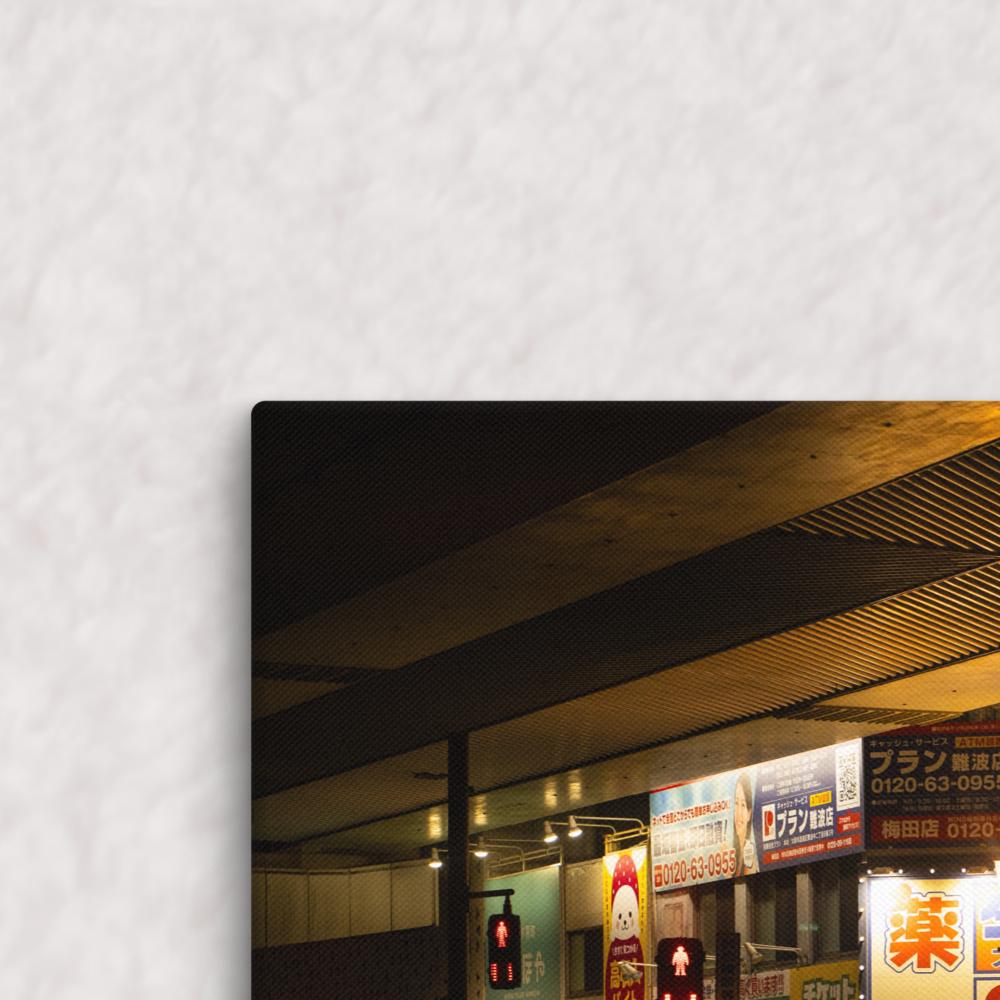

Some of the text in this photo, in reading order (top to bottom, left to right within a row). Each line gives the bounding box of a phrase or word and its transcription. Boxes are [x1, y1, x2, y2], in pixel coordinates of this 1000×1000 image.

[870, 749, 947, 775] プラン
[777, 809, 808, 838] プラン
[882, 820, 939, 839] 梅田店
[663, 849, 736, 885] 0120-63-0955
[888, 891, 961, 969] 薬
